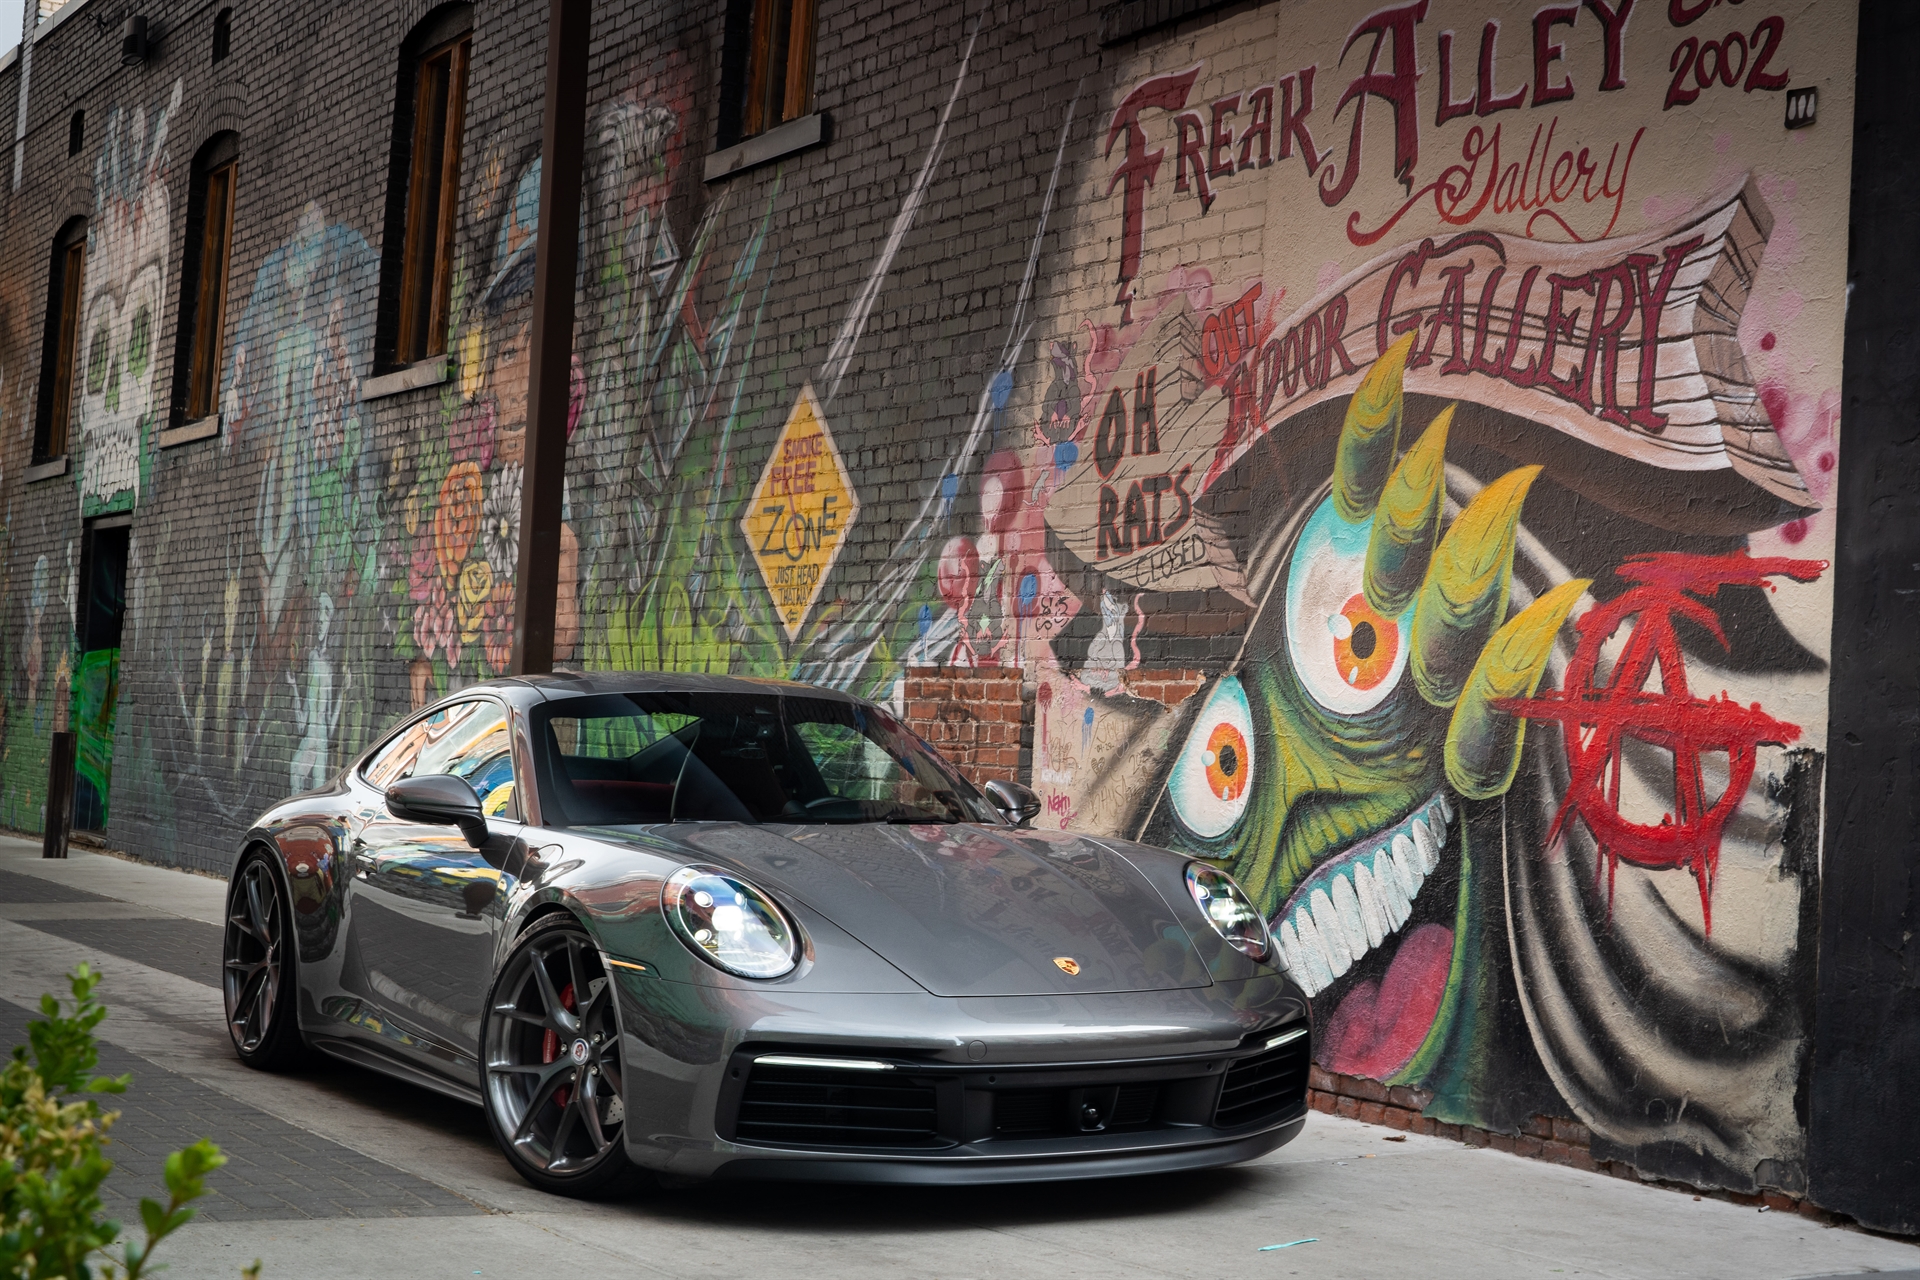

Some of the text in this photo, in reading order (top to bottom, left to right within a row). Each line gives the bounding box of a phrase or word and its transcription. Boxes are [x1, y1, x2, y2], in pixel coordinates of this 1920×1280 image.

[1662, 15, 1791, 112] 2002
[1105, 0, 1637, 328] FREAK ALLEY
[1345, 116, 1647, 247] Gallery
[1201, 281, 1263, 377] OUT
[1375, 230, 1706, 436] GALLERY
[783, 432, 824, 463] SMOKE
[1092, 364, 1161, 481] OH
[770, 461, 818, 496] FREE
[1095, 462, 1193, 562] RATS
[759, 495, 838, 562] ZONE
[774, 565, 796, 585] JUST
[1136, 533, 1208, 588] CLOSED
